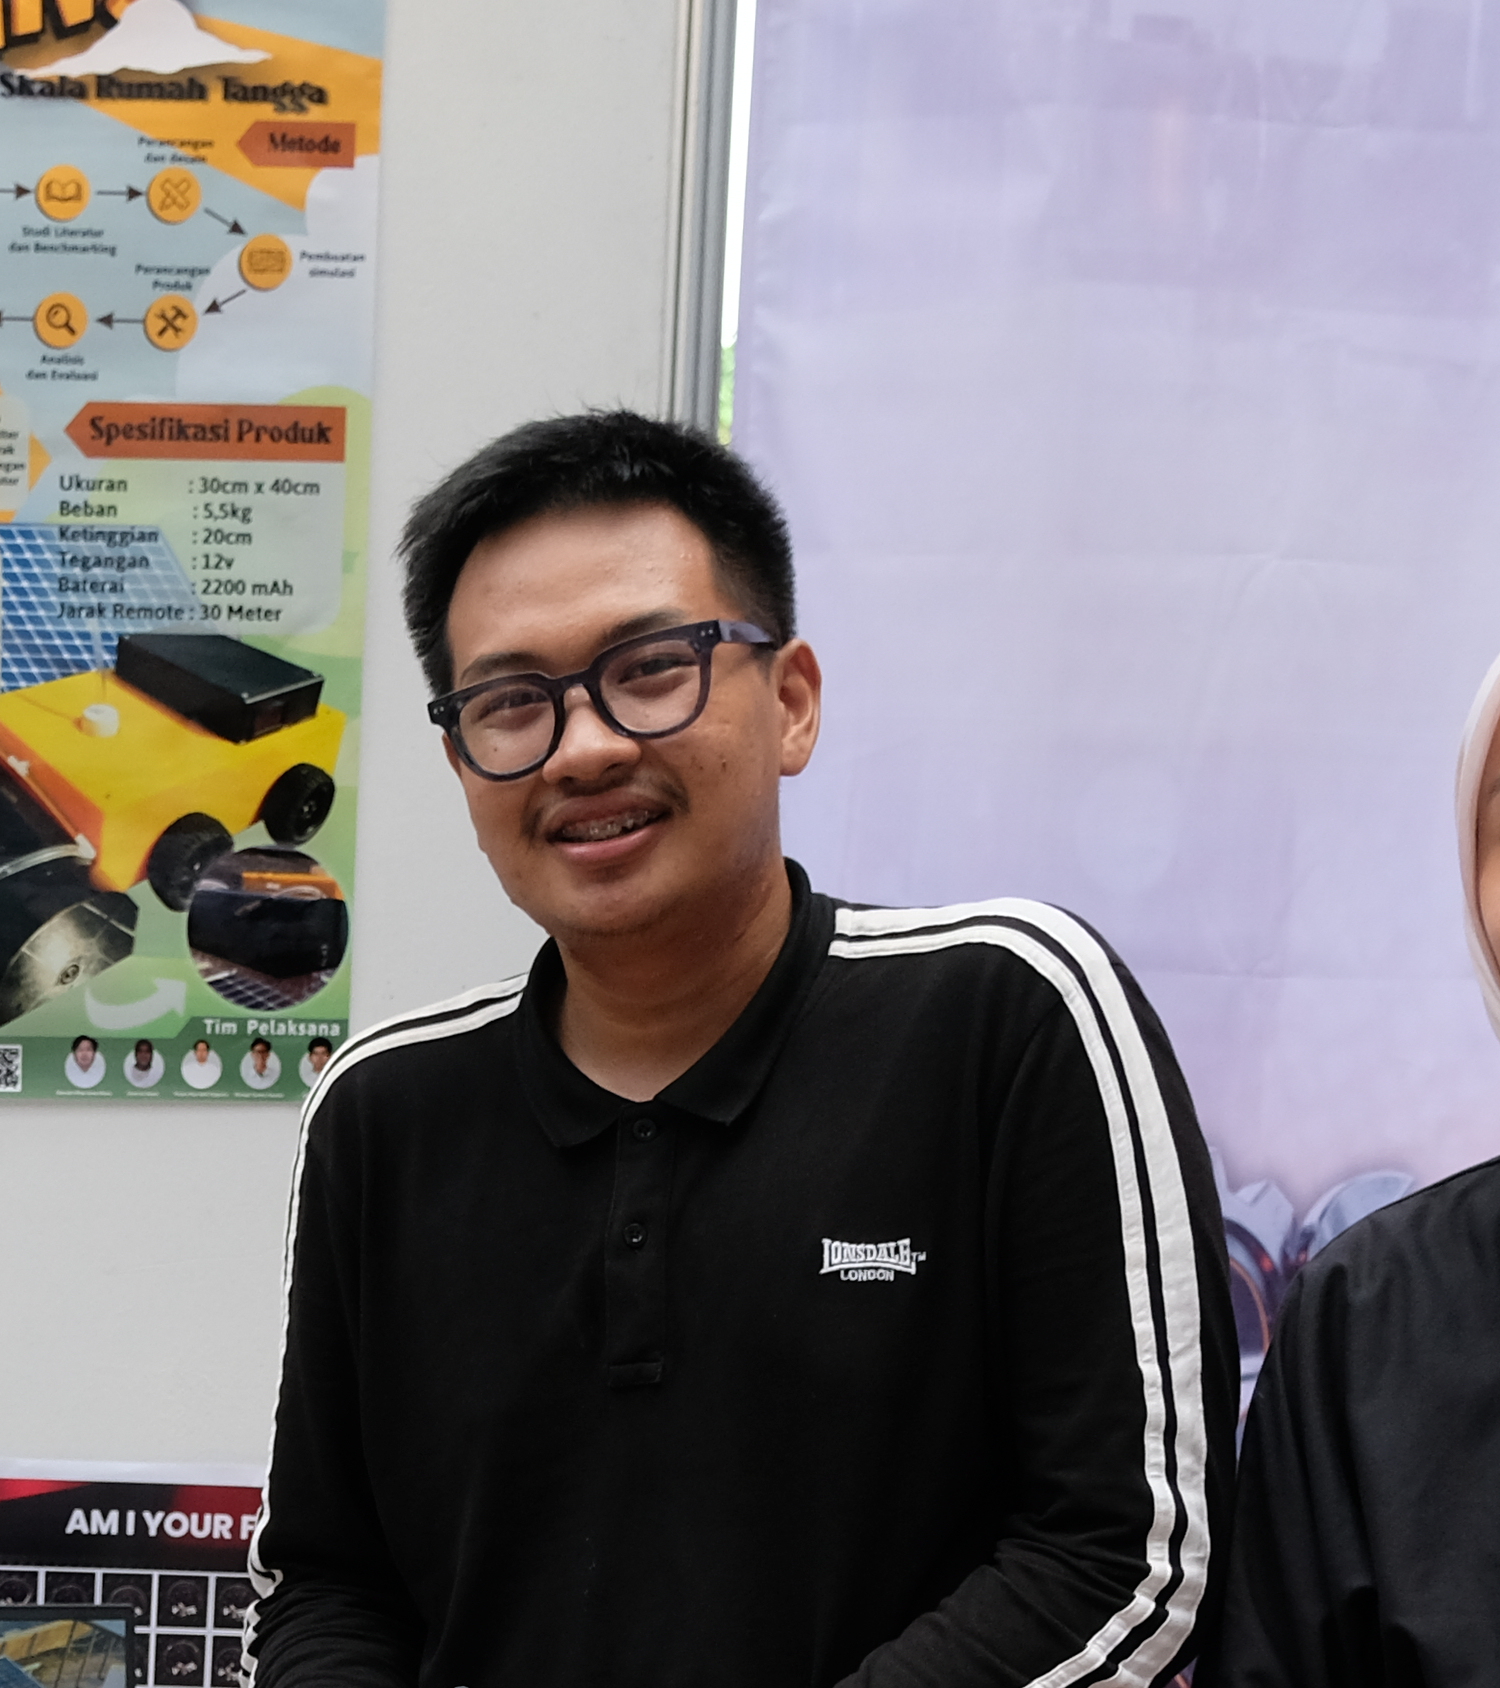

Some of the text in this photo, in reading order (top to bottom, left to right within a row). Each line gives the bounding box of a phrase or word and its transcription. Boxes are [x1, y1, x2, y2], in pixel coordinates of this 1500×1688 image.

[0, 72, 86, 101] Skala
[96, 74, 207, 102] Rumah
[220, 76, 329, 114] Tangga
[267, 132, 342, 156] Metode
[89, 415, 333, 447] Spesifikasi Produk
[59, 475, 128, 493] Ukuran
[198, 477, 249, 495] 30cm
[268, 478, 321, 496] 40cm
[59, 501, 253, 524] Beban 5,5kg
[58, 527, 253, 548] Ketinggian 20cm
[58, 552, 150, 573] Tegangan
[57, 576, 293, 596] Baterai 2200 mAh
[56, 602, 283, 622] Jarak Remote 30 Meter
[204, 1019, 341, 1038] Tim Pelaksana
[819, 1237, 917, 1275] LONSDALE
[840, 1269, 895, 1282] LONDON
[65, 1508, 120, 1537] AM
[125, 1510, 136, 1537] I
[142, 1510, 234, 1541] YOUR
